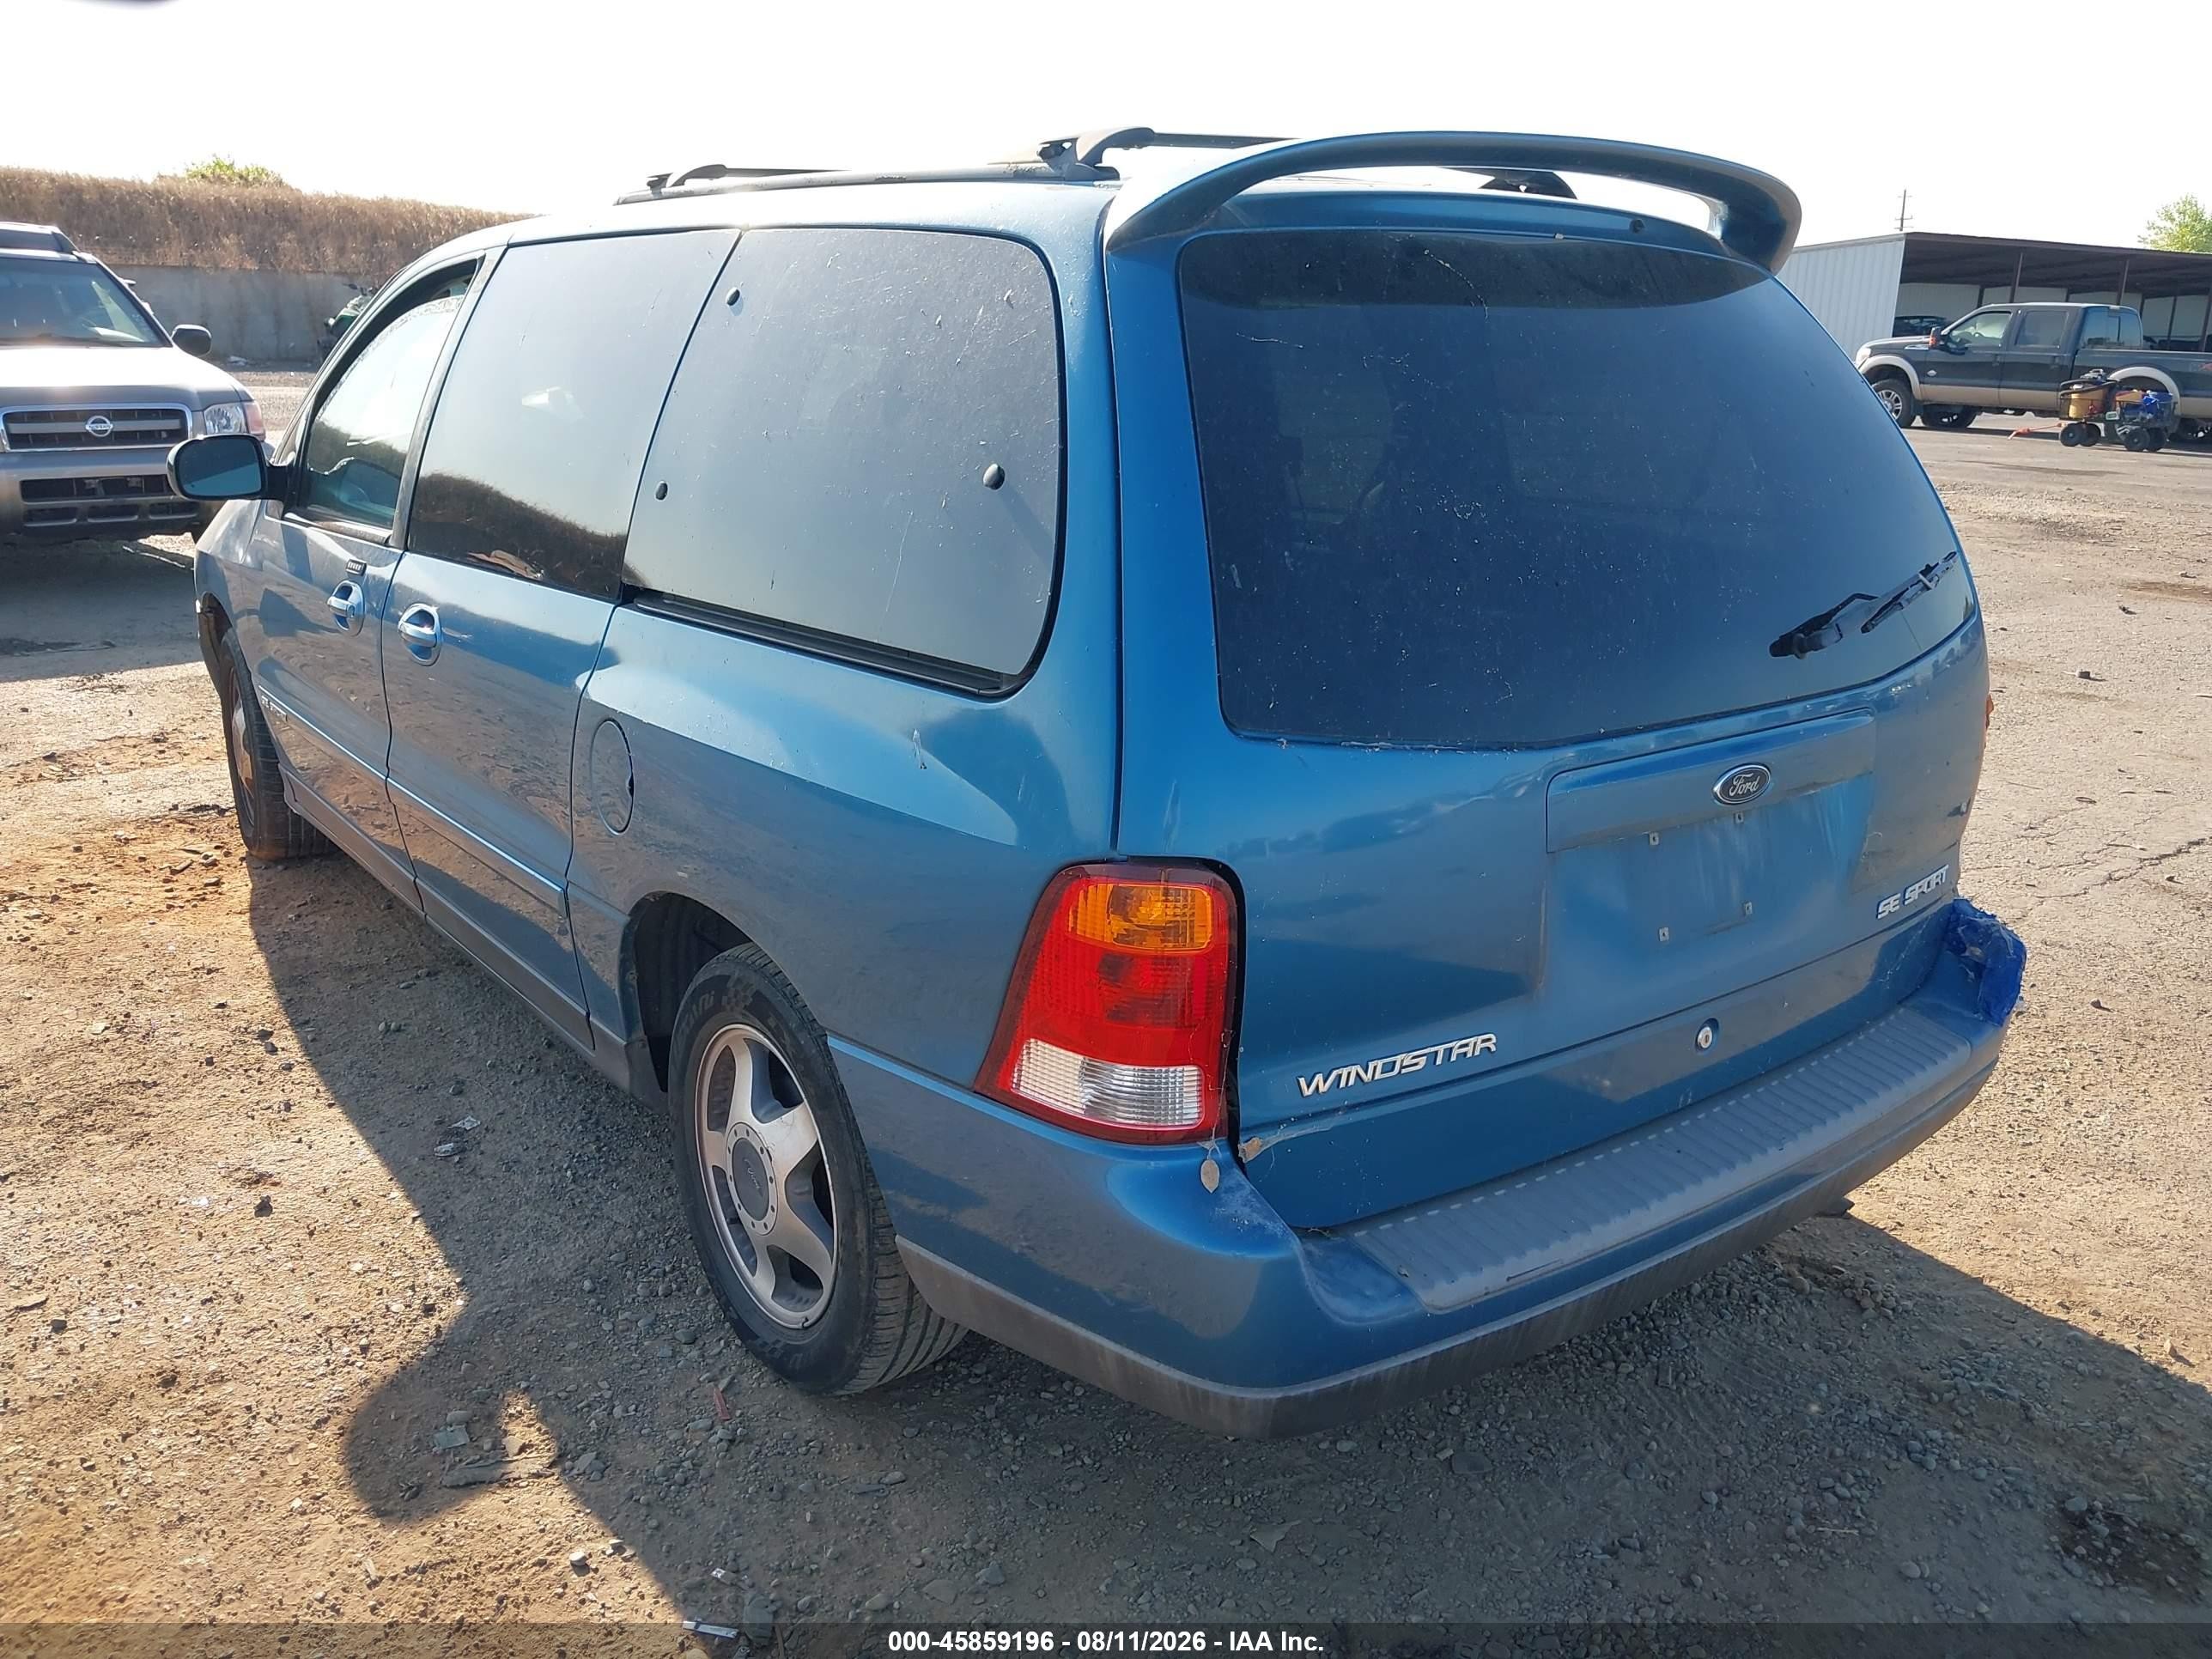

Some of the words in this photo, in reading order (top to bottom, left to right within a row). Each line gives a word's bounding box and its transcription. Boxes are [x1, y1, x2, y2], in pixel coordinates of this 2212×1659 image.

[1729, 772, 1760, 797] Ford
[1877, 892, 1901, 920] SE
[1904, 864, 1949, 906] SPORT
[1297, 1032, 1497, 1097] WINDSTAR
